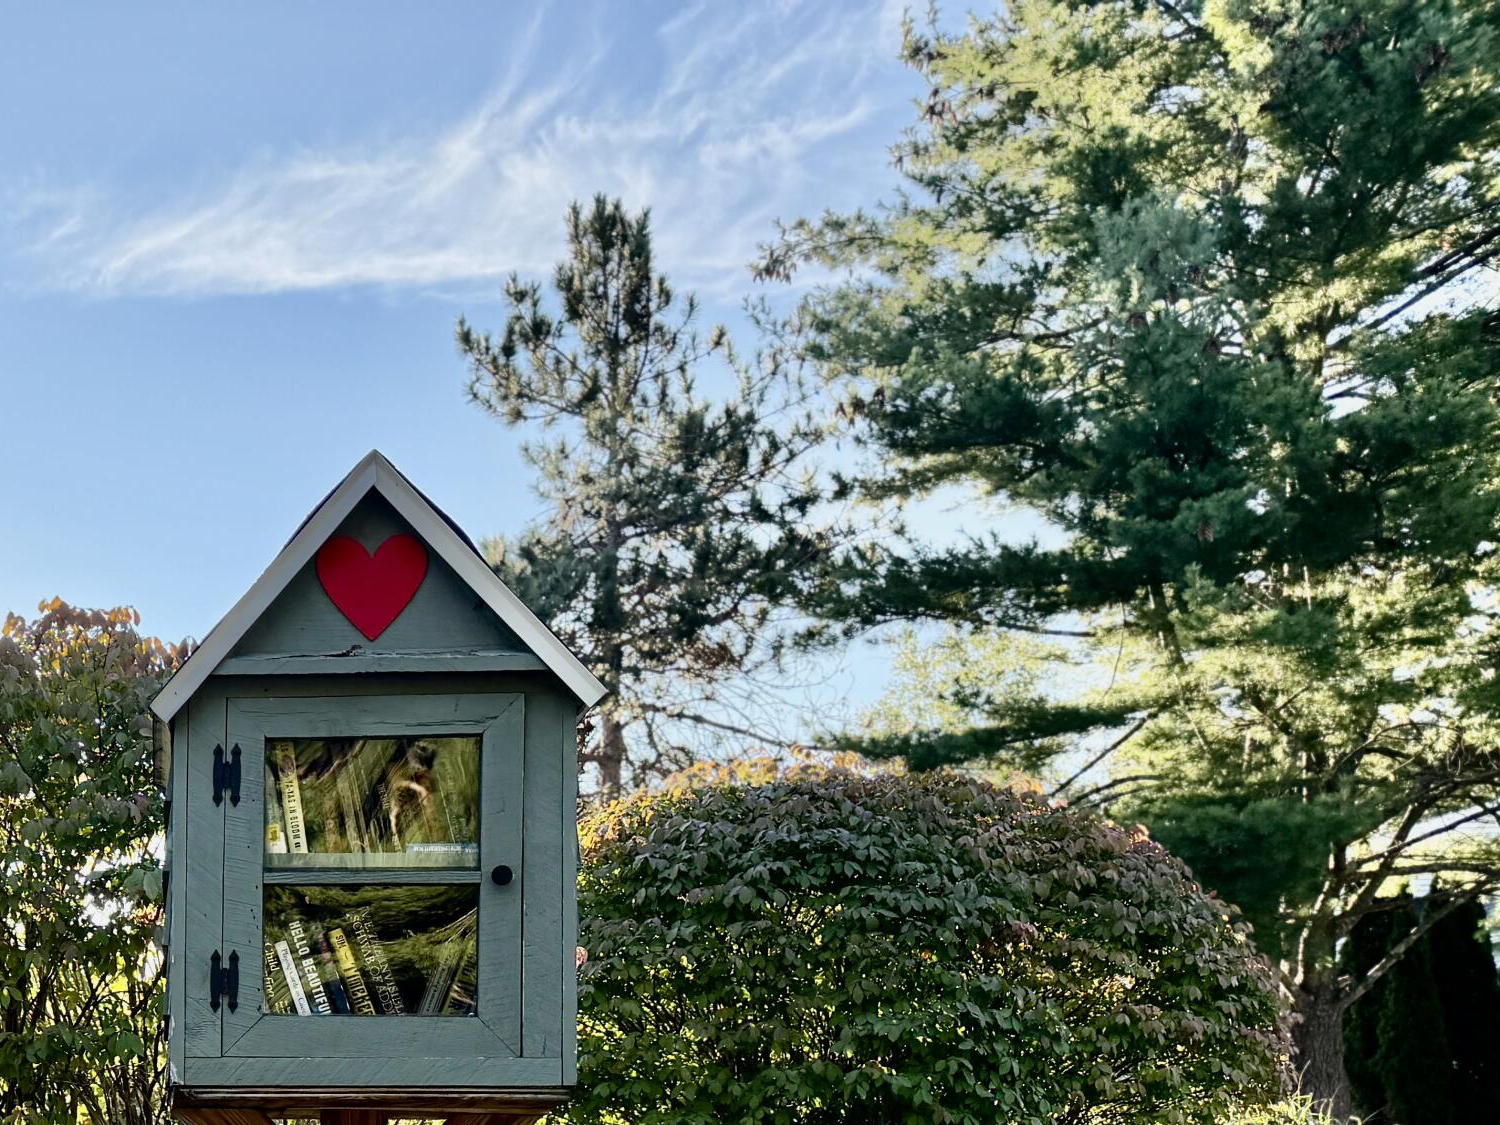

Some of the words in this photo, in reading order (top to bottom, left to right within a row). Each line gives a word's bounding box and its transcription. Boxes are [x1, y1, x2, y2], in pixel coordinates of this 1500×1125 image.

[284, 780, 295, 803] YA-YAS
[288, 805, 296, 813] IN
[289, 816, 300, 839] BLOOM
[288, 920, 310, 956] HELLO
[352, 916, 375, 964] SCHWAB
[263, 941, 279, 971] Child
[369, 967, 384, 984] OF
